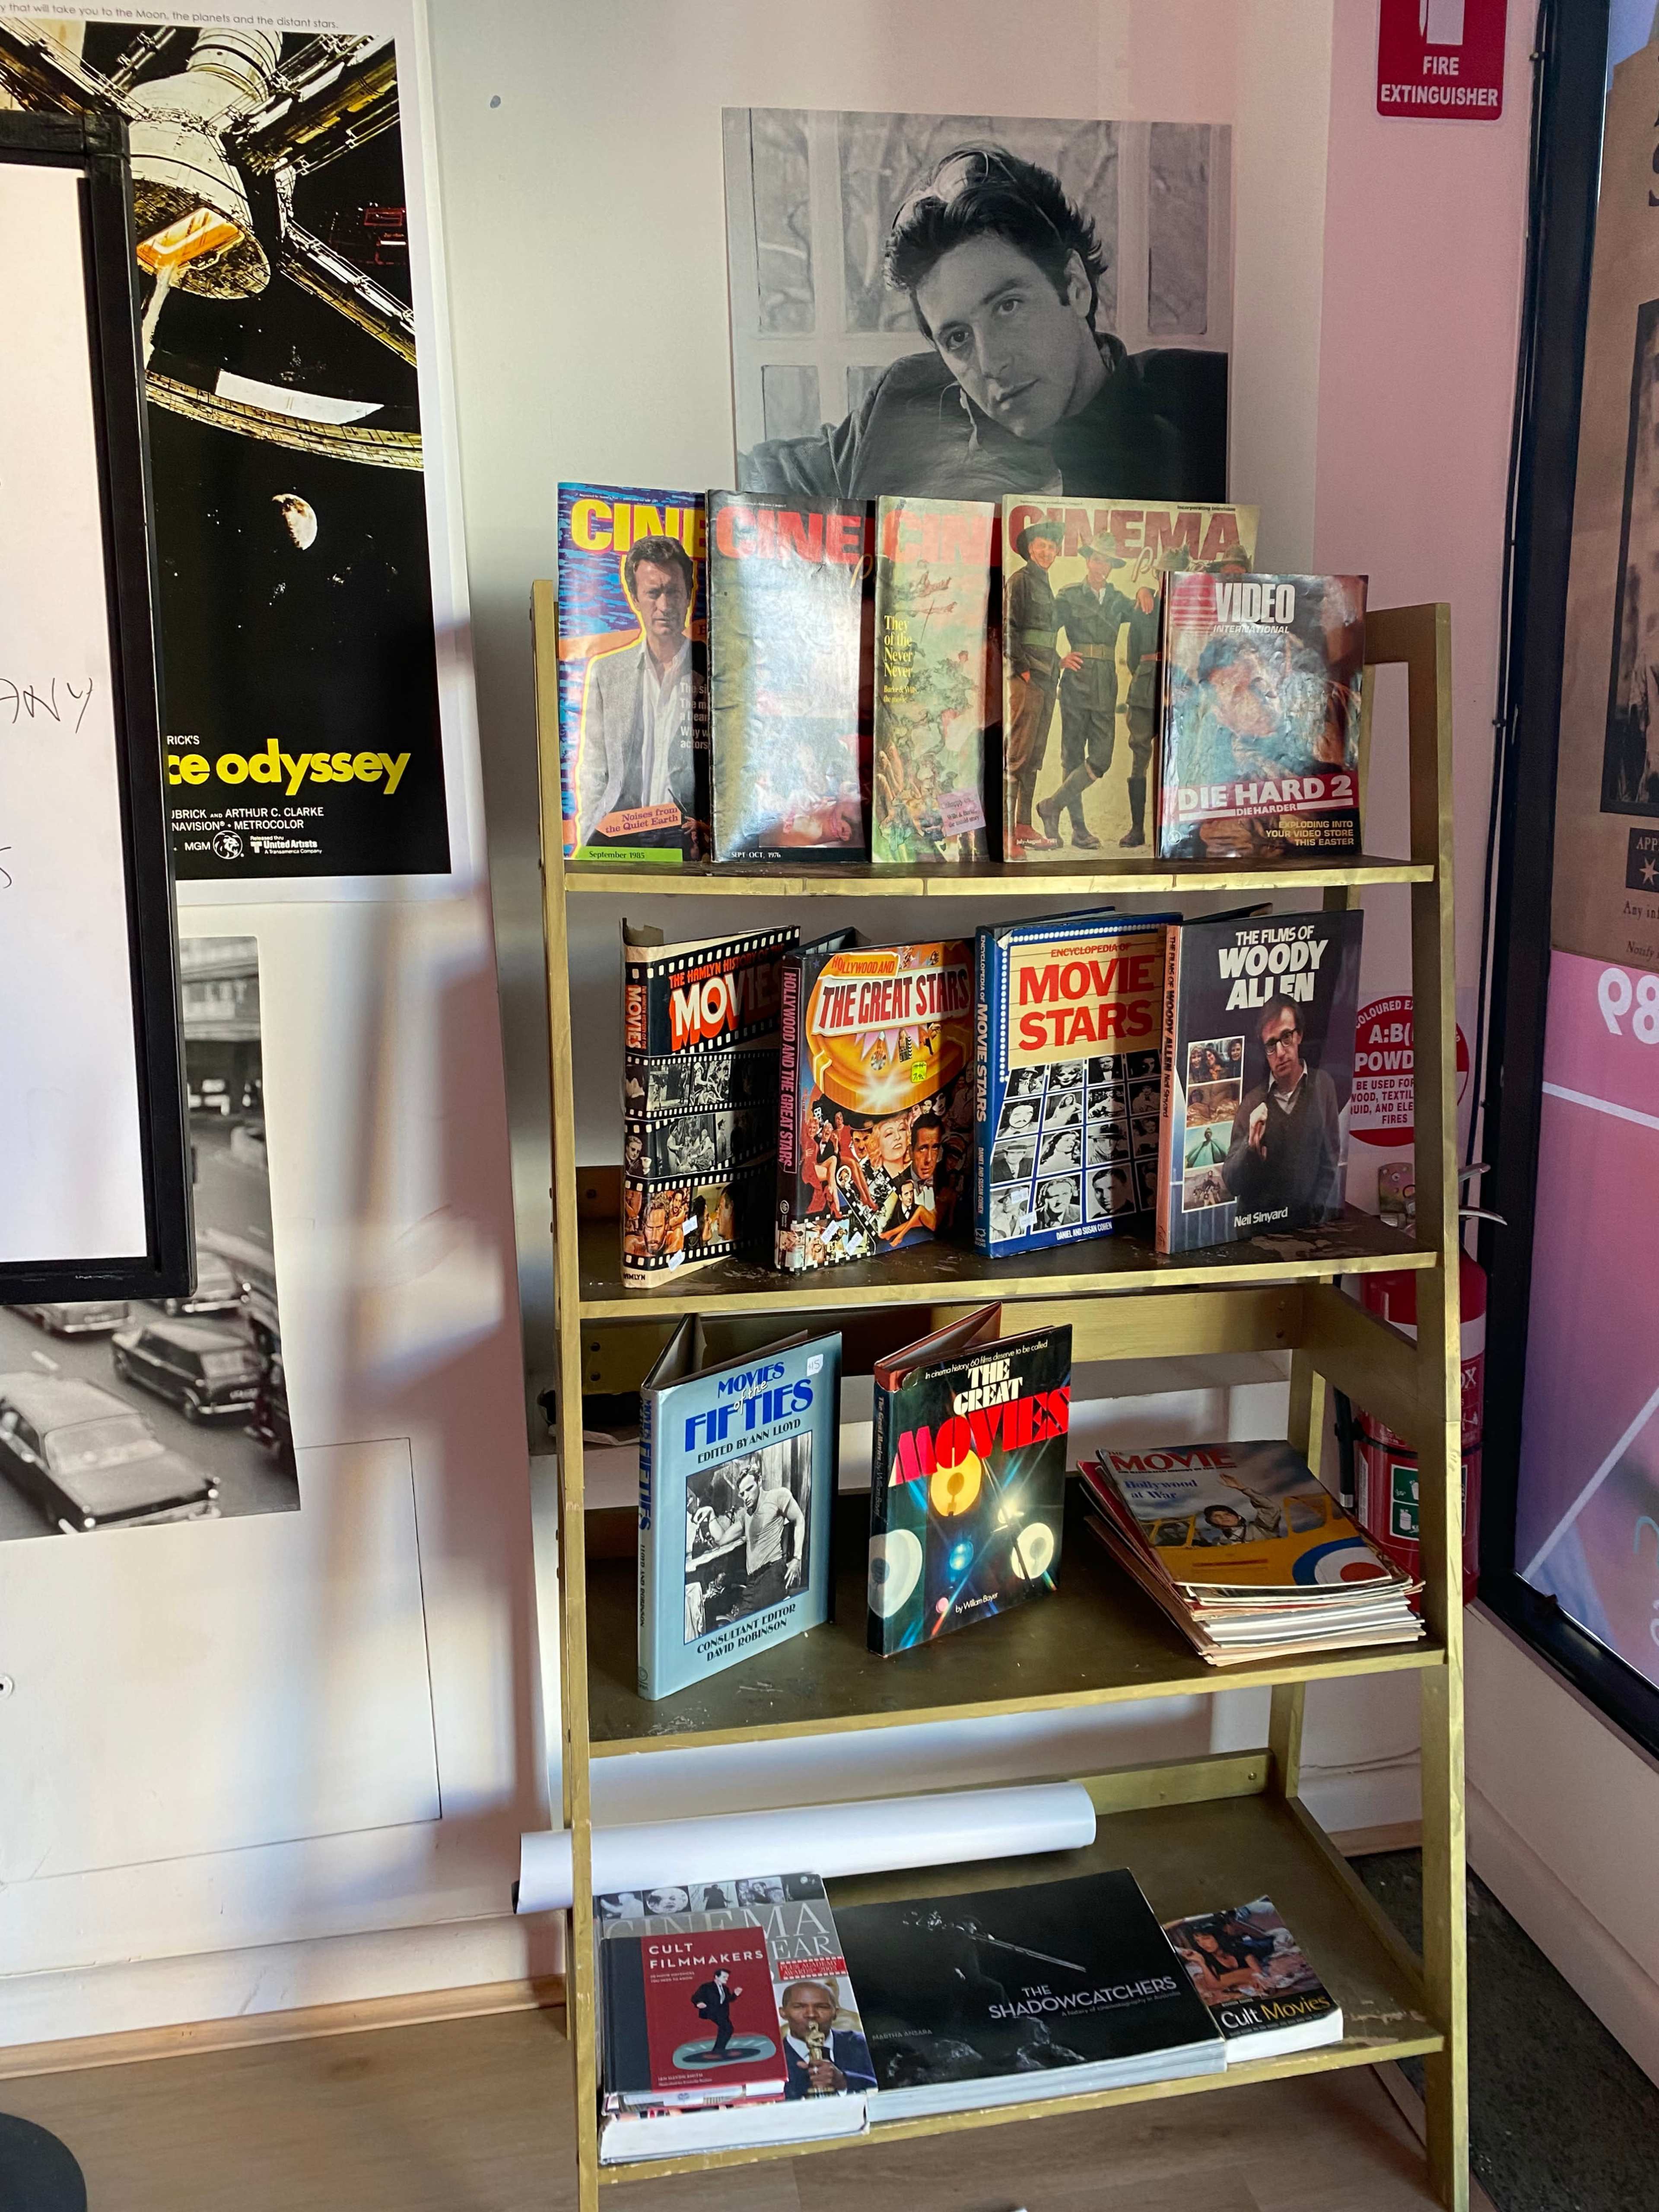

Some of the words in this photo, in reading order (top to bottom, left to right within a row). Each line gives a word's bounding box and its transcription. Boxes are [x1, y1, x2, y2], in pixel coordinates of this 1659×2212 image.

[9, 3, 30, 12] that
[34, 4, 50, 13] will
[53, 6, 76, 14] take
[79, 8, 99, 16] you
[102, 8, 113, 16] to
[116, 9, 133, 17] the
[136, 11, 169, 20] Moon,
[172, 12, 190, 21] the
[192, 13, 230, 24] planets
[233, 15, 254, 24] and
[257, 16, 274, 25] the
[276, 17, 311, 27] distant
[313, 19, 339, 29] stars.
[1423, 56, 1459, 76] FIRE
[1381, 84, 1498, 106] EXTINGUISHER
[1008, 504, 1240, 561] CINEMA
[1215, 582, 1295, 624] VIDEO
[884, 615, 909, 633] They
[1213, 624, 1290, 634] INTERNATIONAL
[884, 631, 895, 646] of
[897, 632, 912, 646] the
[884, 646, 913, 662] Never
[884, 662, 913, 677] Never
[167, 735, 200, 745] RICK'S
[216, 738, 411, 796] odyssey
[1178, 785, 1228, 811] DIE
[1234, 777, 1325, 806] HARD
[1330, 775, 1353, 798] 2
[225, 807, 268, 818] ARTHUR
[270, 808, 281, 817] C.
[283, 807, 324, 817] CLARKE
[622, 811, 653, 822] Noises
[655, 807, 678, 816] from
[1253, 803, 1297, 816] HARDER
[234, 819, 304, 830] METROCOLOR
[606, 825, 620, 833] the
[623, 819, 648, 831] Quiet
[651, 814, 678, 826] Earth
[1278, 820, 1329, 829] EXPLODING
[184, 842, 211, 851] MGM
[264, 840, 290, 849] United
[291, 839, 318, 849] Artists
[1318, 838, 1354, 846] EASTER
[589, 851, 627, 859] September
[1623, 900, 1642, 921] Any
[1235, 930, 1259, 946] THE
[1261, 926, 1296, 944] FILMS
[1297, 925, 1315, 940] OF
[1050, 944, 1118, 958] ENCYCLOPEDIA
[1119, 942, 1132, 951] OF
[1218, 939, 1329, 979] WOODY
[668, 971, 685, 989] THE
[687, 961, 721, 984] HAMLYN
[723, 950, 756, 972] HISTORY
[831, 956, 878, 974] HOLLYWOOD
[878, 960, 896, 974] AND
[1019, 954, 1155, 1006] MOVIE
[1167, 977, 1174, 988] OF
[819, 983, 857, 1029] THE
[858, 976, 913, 1025] GREAT
[915, 968, 970, 1016] STARS
[980, 992, 985, 1001] OF
[1225, 972, 1315, 1011] ALLEN
[626, 985, 642, 1049] MOVIES
[782, 972, 797, 1042] HOLLYWOOD
[1166, 990, 1175, 1035] WOODY
[976, 1004, 988, 1063] MOVIE
[1018, 999, 1154, 1051] STARS
[782, 1043, 795, 1068] AND
[1163, 1037, 1173, 1074] ALLEN
[781, 1070, 794, 1093] THE
[1356, 1081, 1368, 1090] BE
[1371, 1079, 1395, 1089] USED
[976, 1065, 988, 1122] STARS
[1382, 1090, 1414, 1101] TEXTIL
[780, 1093, 794, 1131] GREAT
[1375, 1103, 1394, 1112] AND
[1397, 1101, 1413, 1112] ELE
[1382, 1113, 1408, 1124] FIRES
[779, 1130, 793, 1166] STARS
[1233, 1213, 1252, 1228] Neil
[1252, 1207, 1288, 1224] Sinyard
[1056, 1230, 1073, 1240] DANIEL
[1072, 1228, 1083, 1237] AND
[1082, 1225, 1098, 1235] SUSAN
[1097, 1221, 1113, 1232] COHEN
[931, 1368, 951, 1378] cinema
[970, 1357, 980, 1367] 60
[980, 1355, 992, 1365] films
[992, 1350, 1015, 1361] deserve
[1022, 1344, 1030, 1353] be
[1030, 1339, 1048, 1351] called
[718, 1361, 785, 1398] MOVIES
[967, 1357, 1011, 1389] THE
[734, 1388, 747, 1415] of
[747, 1380, 768, 1399] the
[953, 1376, 1023, 1416] GREAT
[685, 1378, 814, 1452] FIFTIES
[698, 1442, 734, 1464] EDITED
[736, 1436, 748, 1448] BY
[748, 1429, 770, 1445] ANN
[773, 1418, 801, 1437] LLOYD
[896, 1386, 1071, 1484] MOVIES
[1109, 1449, 1236, 1471] MOVIE
[1124, 1479, 1198, 1490] Hollywood
[1148, 1491, 1176, 1500] War
[955, 1604, 963, 1614] by
[963, 1598, 983, 1610] William
[982, 1592, 999, 1604] Bayer
[697, 1618, 760, 1654] CONSULTANT
[762, 1603, 796, 1625] EDITOR
[706, 1643, 734, 1662] DAVID
[738, 1618, 788, 1647] ROBINSON
[648, 1942, 693, 1955] CULT
[649, 1949, 764, 1969] FILMMAKERS
[988, 1975, 1177, 2020] SHADOWCATCHERS
[1021, 1984, 1052, 1998] THE
[1220, 2007, 1263, 2029] Cult
[1260, 1996, 1331, 2021] Movies
